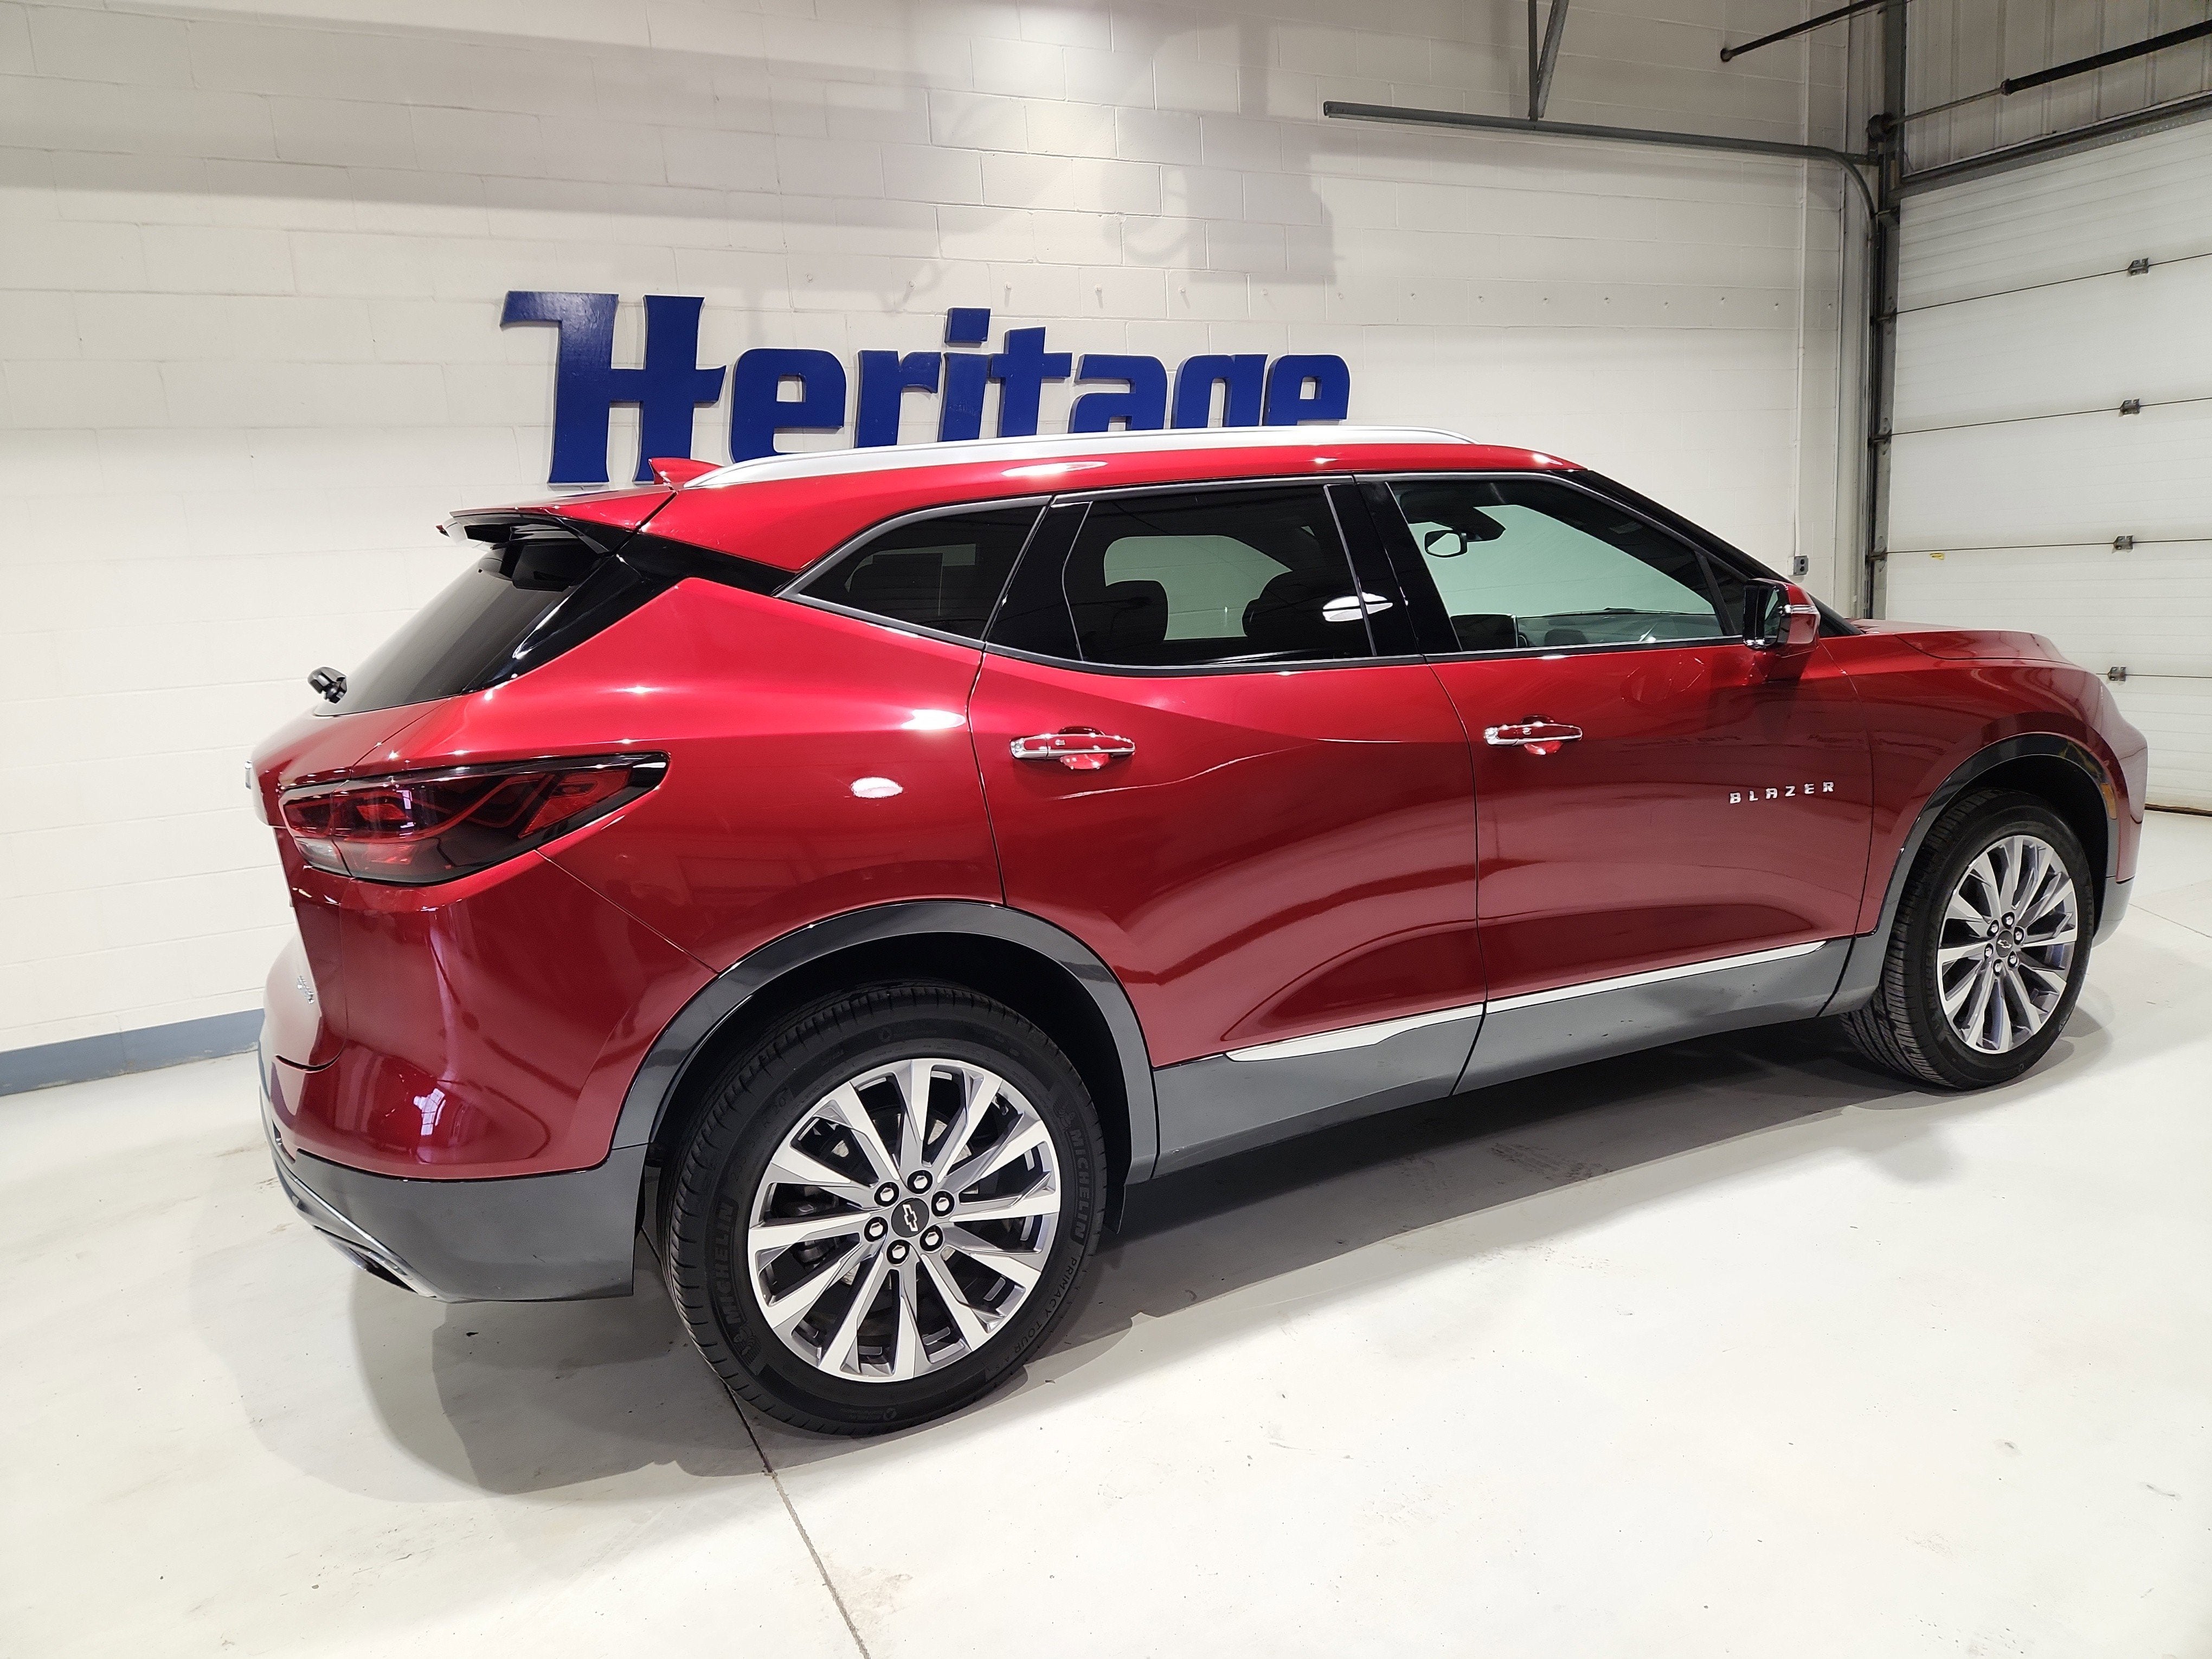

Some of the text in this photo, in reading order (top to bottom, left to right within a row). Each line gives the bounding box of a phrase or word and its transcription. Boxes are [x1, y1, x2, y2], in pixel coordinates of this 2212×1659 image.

[1729, 781, 1835, 804] BLAZER
[1070, 1128, 1090, 1239] MICHELIN
[715, 1201, 741, 1324] MICHELIN
[1045, 1257, 1077, 1318] PRIMACY
[1013, 1321, 1043, 1354] TOUR
